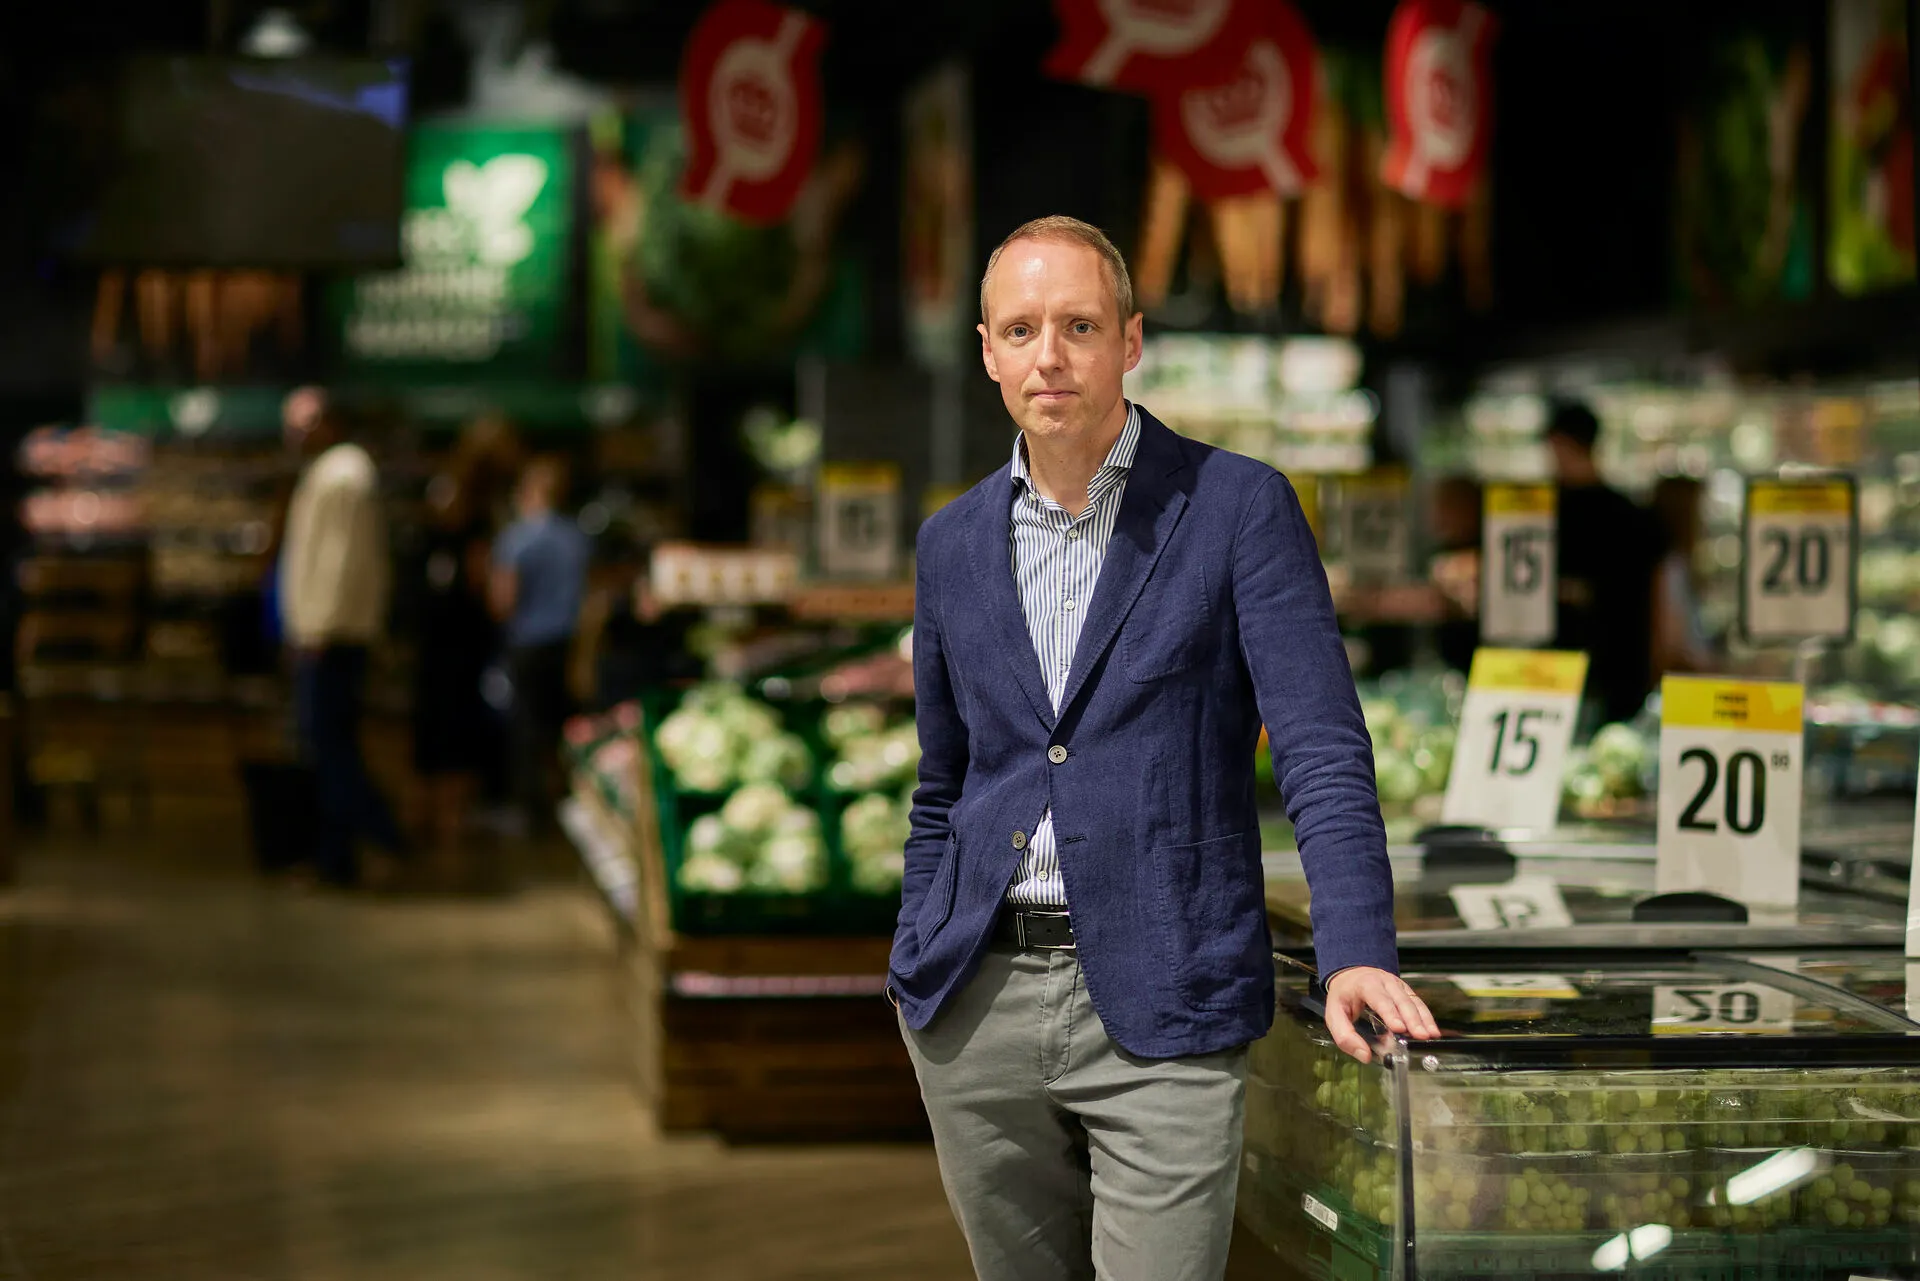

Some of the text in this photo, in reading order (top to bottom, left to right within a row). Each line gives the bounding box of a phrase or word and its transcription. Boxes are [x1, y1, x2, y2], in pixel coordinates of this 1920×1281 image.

[1503, 527, 1542, 595] 15
[1761, 525, 1829, 596] 20
[1490, 708, 1543, 776] 15
[1677, 747, 1766, 834] 20
